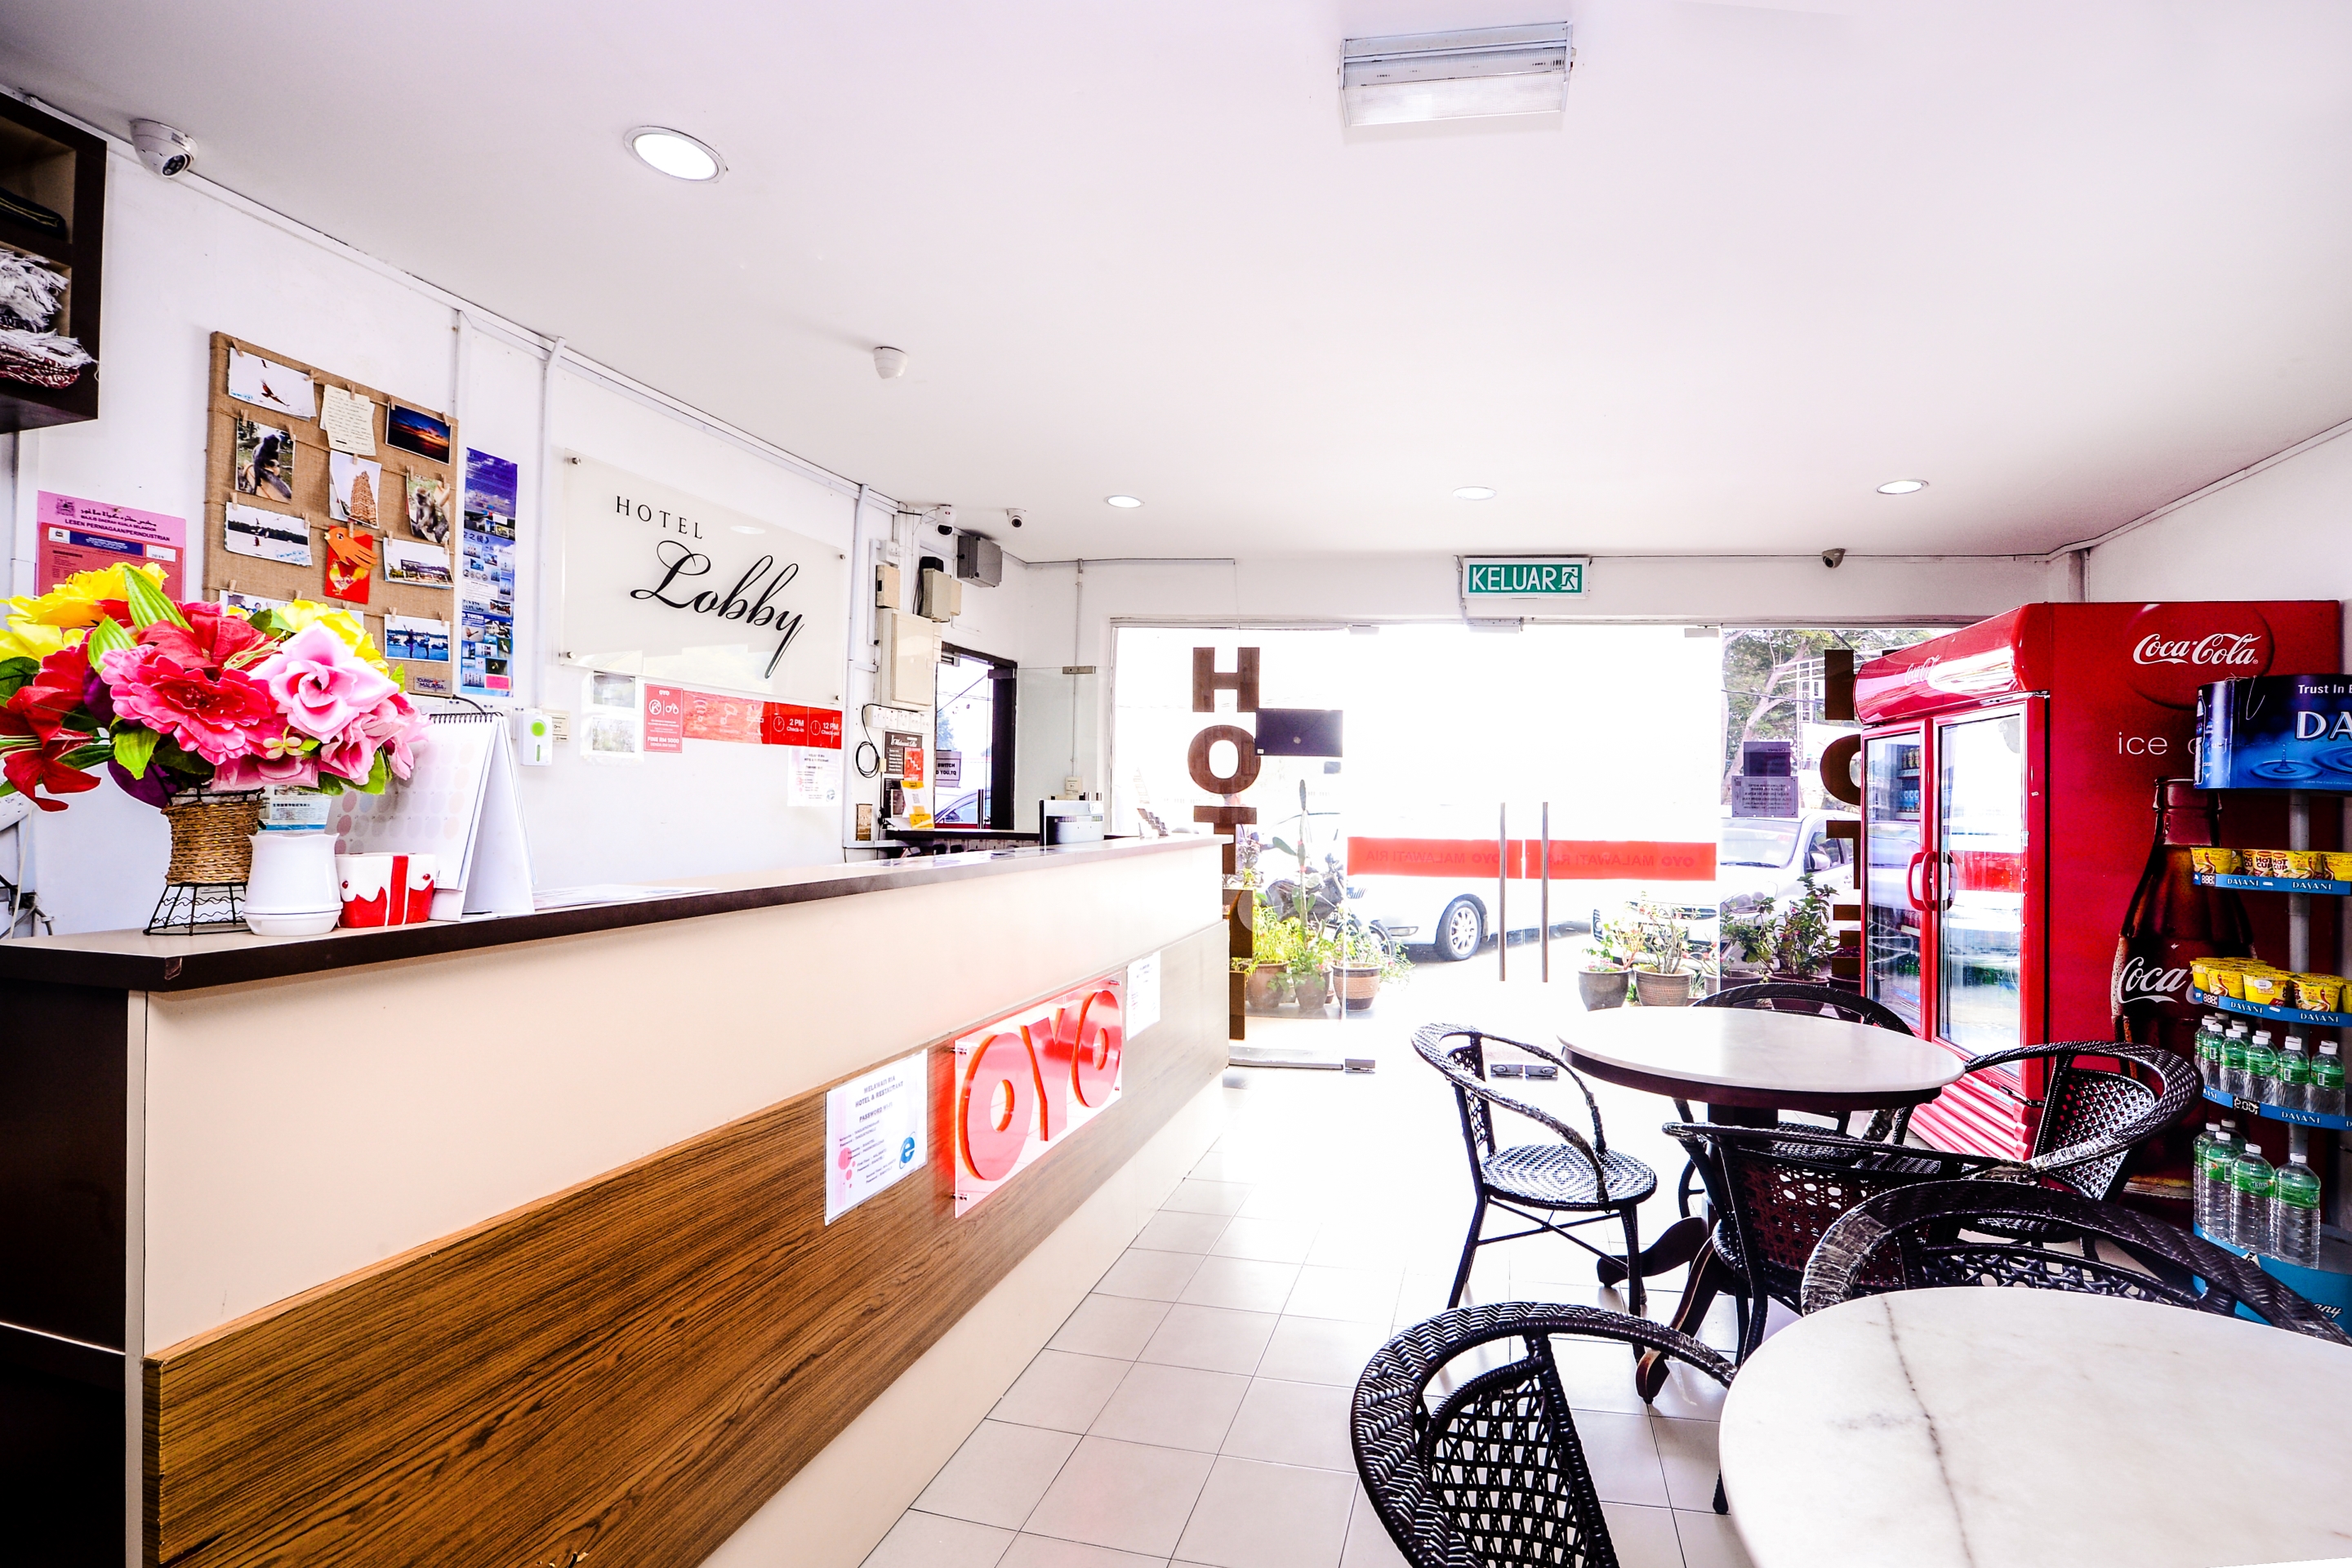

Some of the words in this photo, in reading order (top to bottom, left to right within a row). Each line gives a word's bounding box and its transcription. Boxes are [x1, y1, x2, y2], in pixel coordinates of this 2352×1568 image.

[65, 519, 86, 528] LESEN
[616, 496, 704, 540] HOTEL
[1471, 566, 1557, 592] KELUAR
[630, 540, 805, 679] Lobby
[2132, 633, 2261, 666] Coca-Cola
[2298, 684, 2329, 694] Trust
[2333, 684, 2345, 694] In
[795, 719, 804, 727] PM
[2117, 731, 2167, 755] ice
[2227, 878, 2259, 887] DASANI
[2292, 881, 2332, 890] DASANI
[2230, 1001, 2263, 1013] DASANI
[2300, 1013, 2340, 1023] DASANI
[960, 989, 1121, 1181] OYO
[855, 1097, 870, 1107] HOTEL
[859, 1107, 883, 1123] PASSWORD
[2281, 1111, 2321, 1124] DASANI
